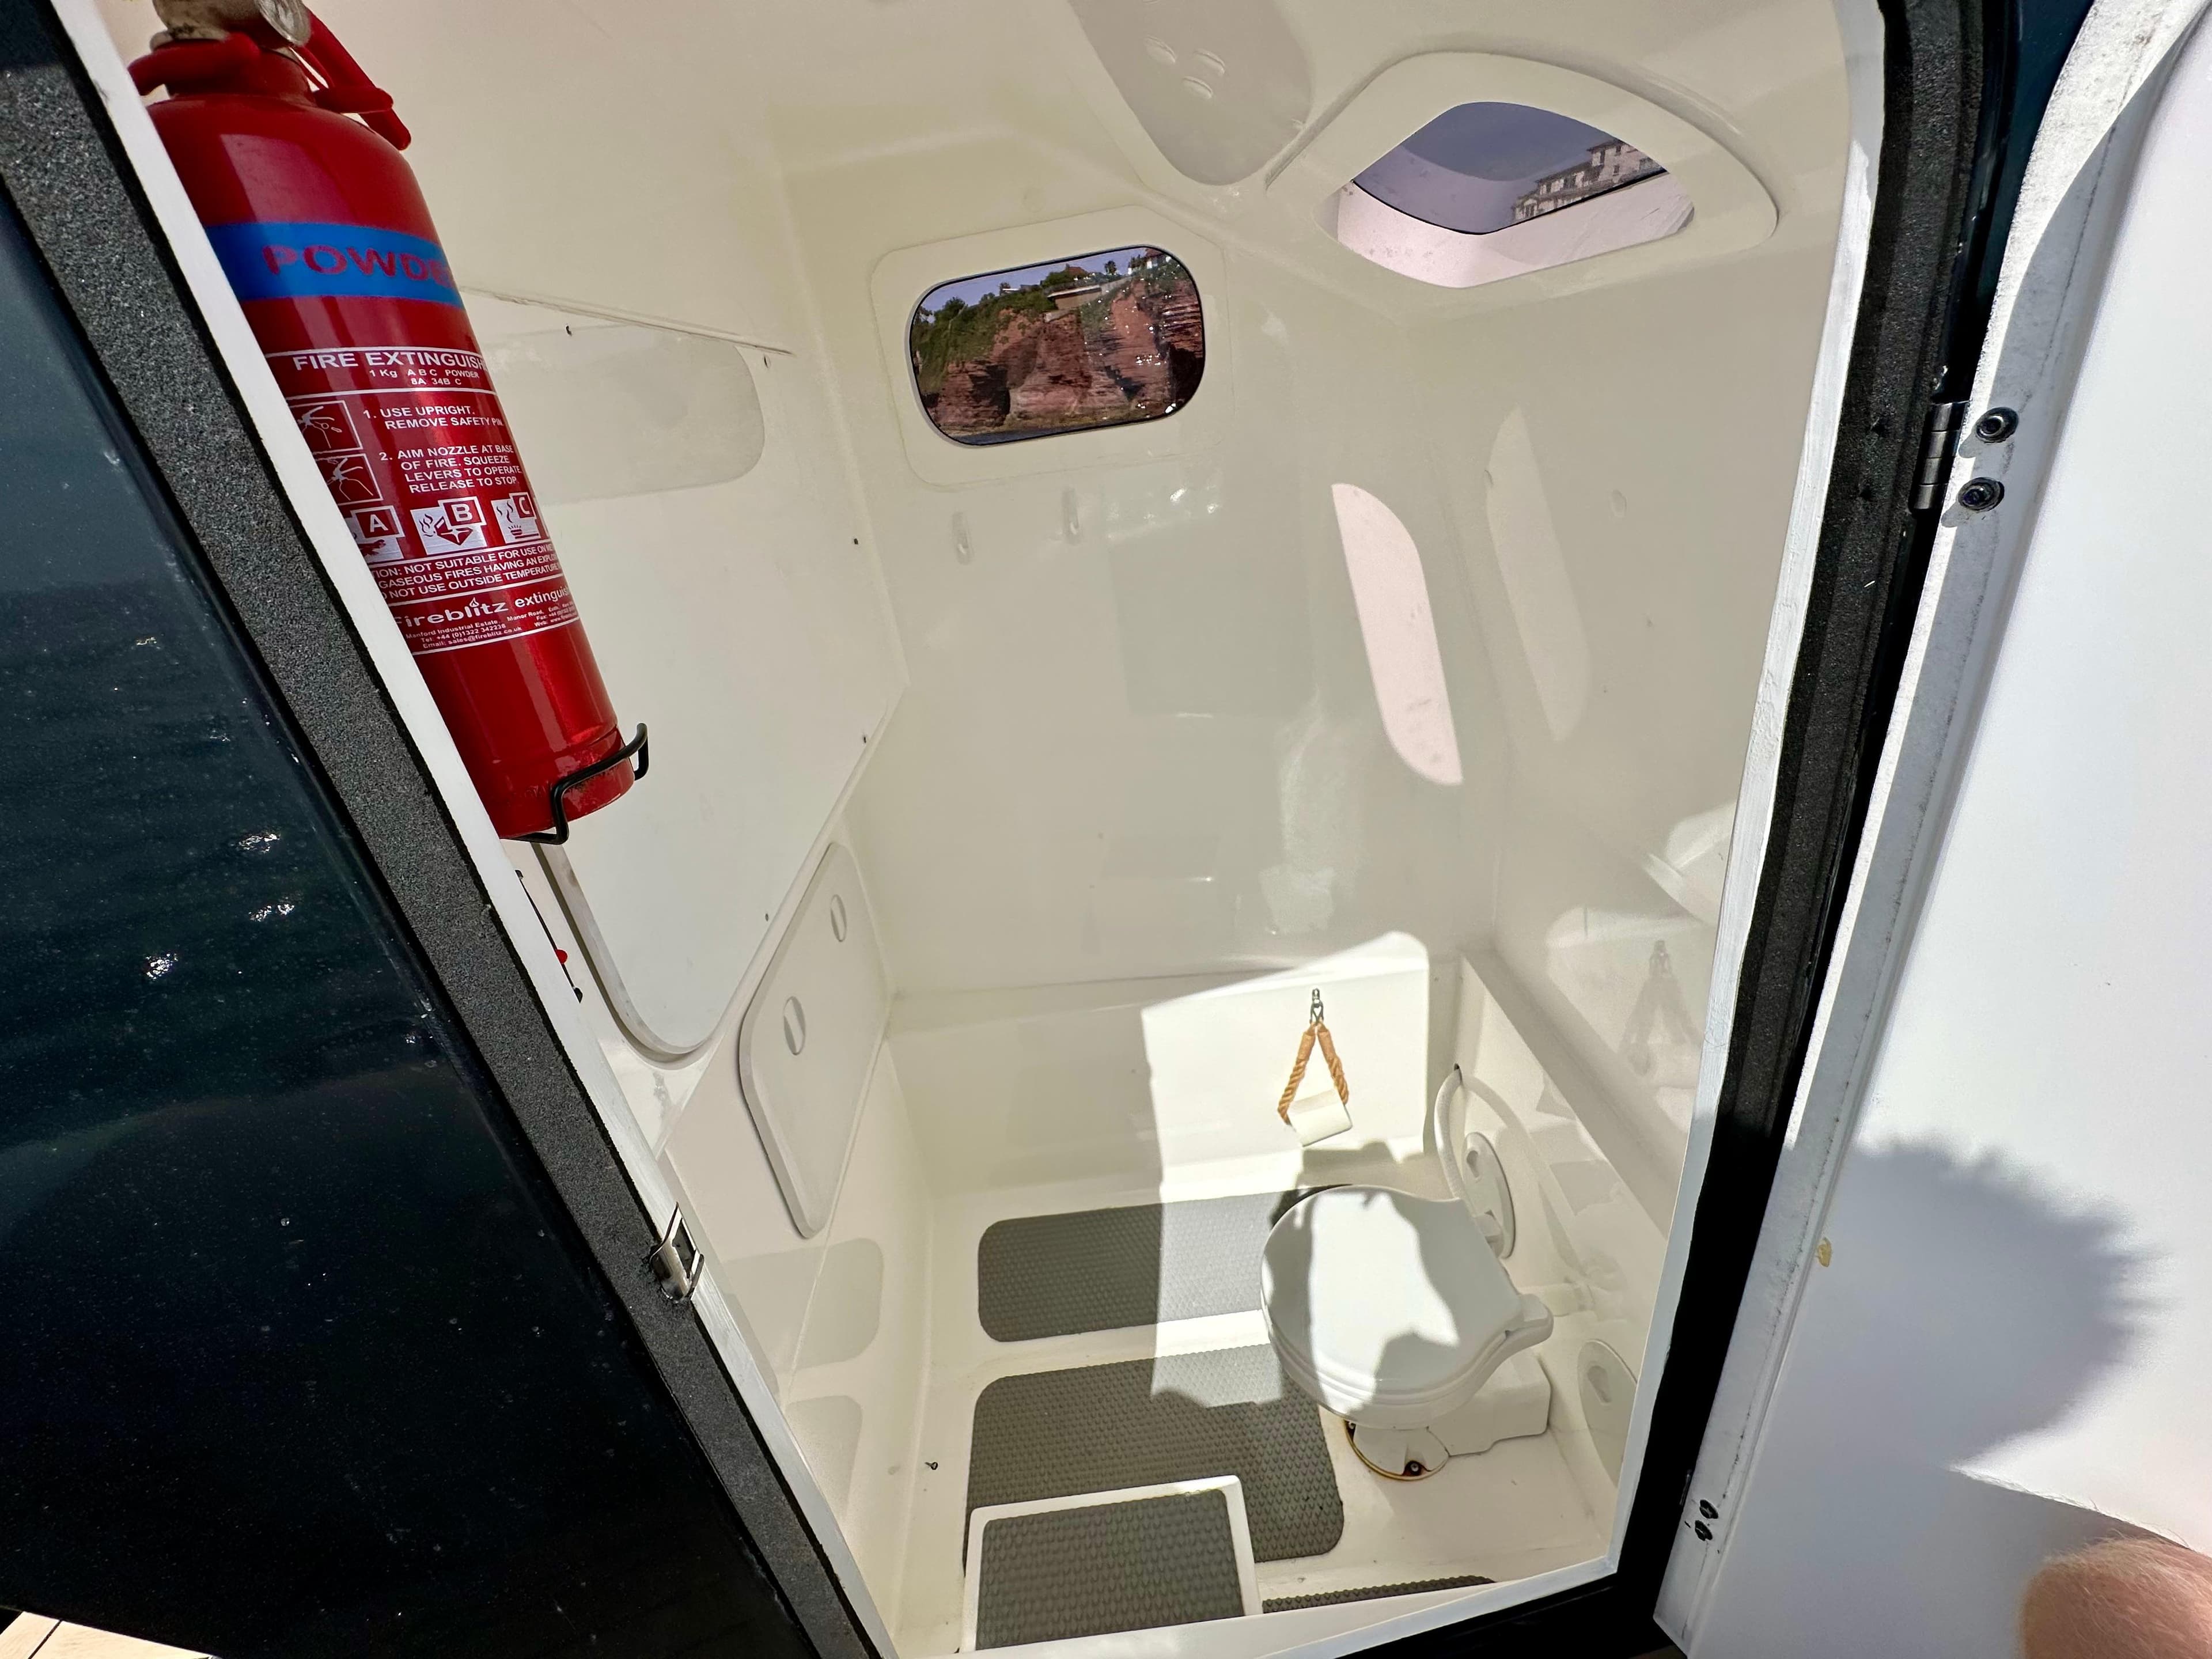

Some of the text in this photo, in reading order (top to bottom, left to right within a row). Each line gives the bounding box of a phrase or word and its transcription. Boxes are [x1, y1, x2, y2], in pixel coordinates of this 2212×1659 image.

[293, 351, 487, 372] FIRE EXTINGUISH
[369, 369, 376, 377] 1
[380, 369, 397, 378] Kg
[445, 369, 480, 378] POWDER
[363, 406, 475, 419] 1. USE UPRIGHT.
[385, 417, 449, 430] REMOVE
[450, 417, 490, 426] SAFETY
[378, 445, 514, 461] 2. AIM NOZZLE AT BASE
[400, 455, 510, 471] OF FIRE. SQUEEZE
[404, 468, 462, 482] LEVERS
[464, 467, 482, 477] TO
[408, 479, 475, 494] RELEASE
[476, 478, 493, 487] TO
[450, 503, 473, 522] B
[518, 497, 531, 515] C
[369, 514, 388, 533] A
[404, 562, 432, 574] NOT
[435, 552, 497, 570] SUITABLE
[498, 549, 521, 560] FOR
[520, 547, 537, 556] USE
[537, 544, 547, 553] ON
[378, 573, 443, 589] GASEOUS
[445, 567, 482, 579] FIRES
[484, 559, 524, 574] HAVING
[527, 556, 538, 566] AN
[389, 587, 415, 599] NOT
[418, 583, 447, 594] USE
[448, 574, 503, 590] OUTSIDE
[514, 585, 568, 608] extinguis
[437, 624, 474, 634] Industrial
